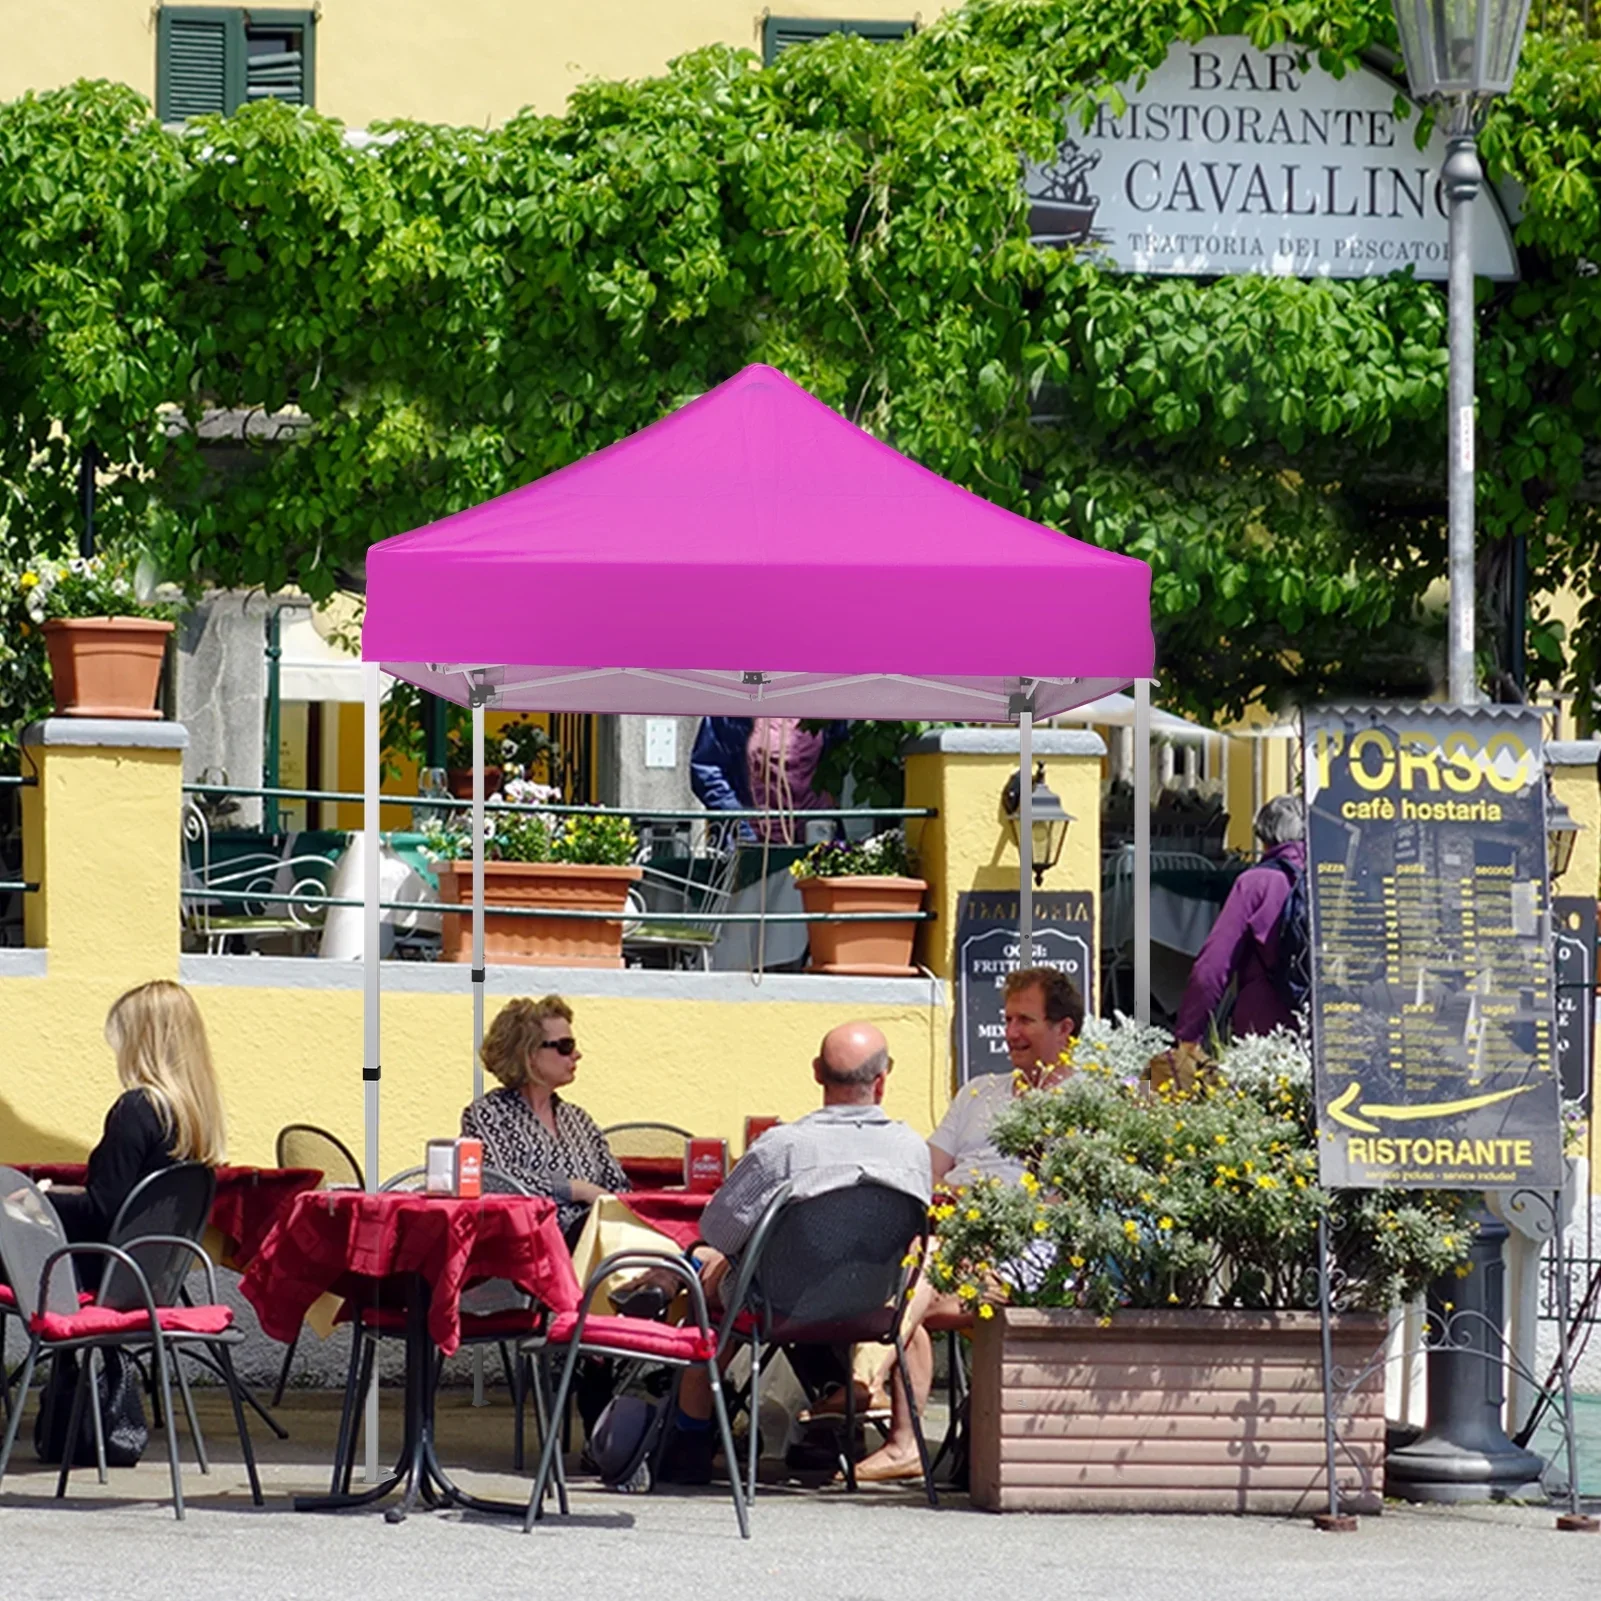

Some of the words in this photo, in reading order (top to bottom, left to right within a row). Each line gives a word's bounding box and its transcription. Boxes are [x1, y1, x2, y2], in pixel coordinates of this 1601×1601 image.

[1188, 51, 1300, 92] BAR
[1092, 101, 1395, 148] RISTORANTE
[1127, 232, 1264, 257] TRATTORIA
[1278, 237, 1321, 259] DEI
[1341, 797, 1396, 819] cafè
[1401, 798, 1503, 822] hostaria
[1318, 862, 1346, 875] pizza
[1475, 864, 1515, 876] secondi
[968, 901, 1089, 921] TRATORIA
[1323, 1001, 1362, 1014] piadine
[1402, 1003, 1434, 1015] panini
[1347, 1137, 1533, 1167] RISTORANTE
[1442, 1170, 1475, 1182] service
[1477, 1170, 1517, 1182] included
